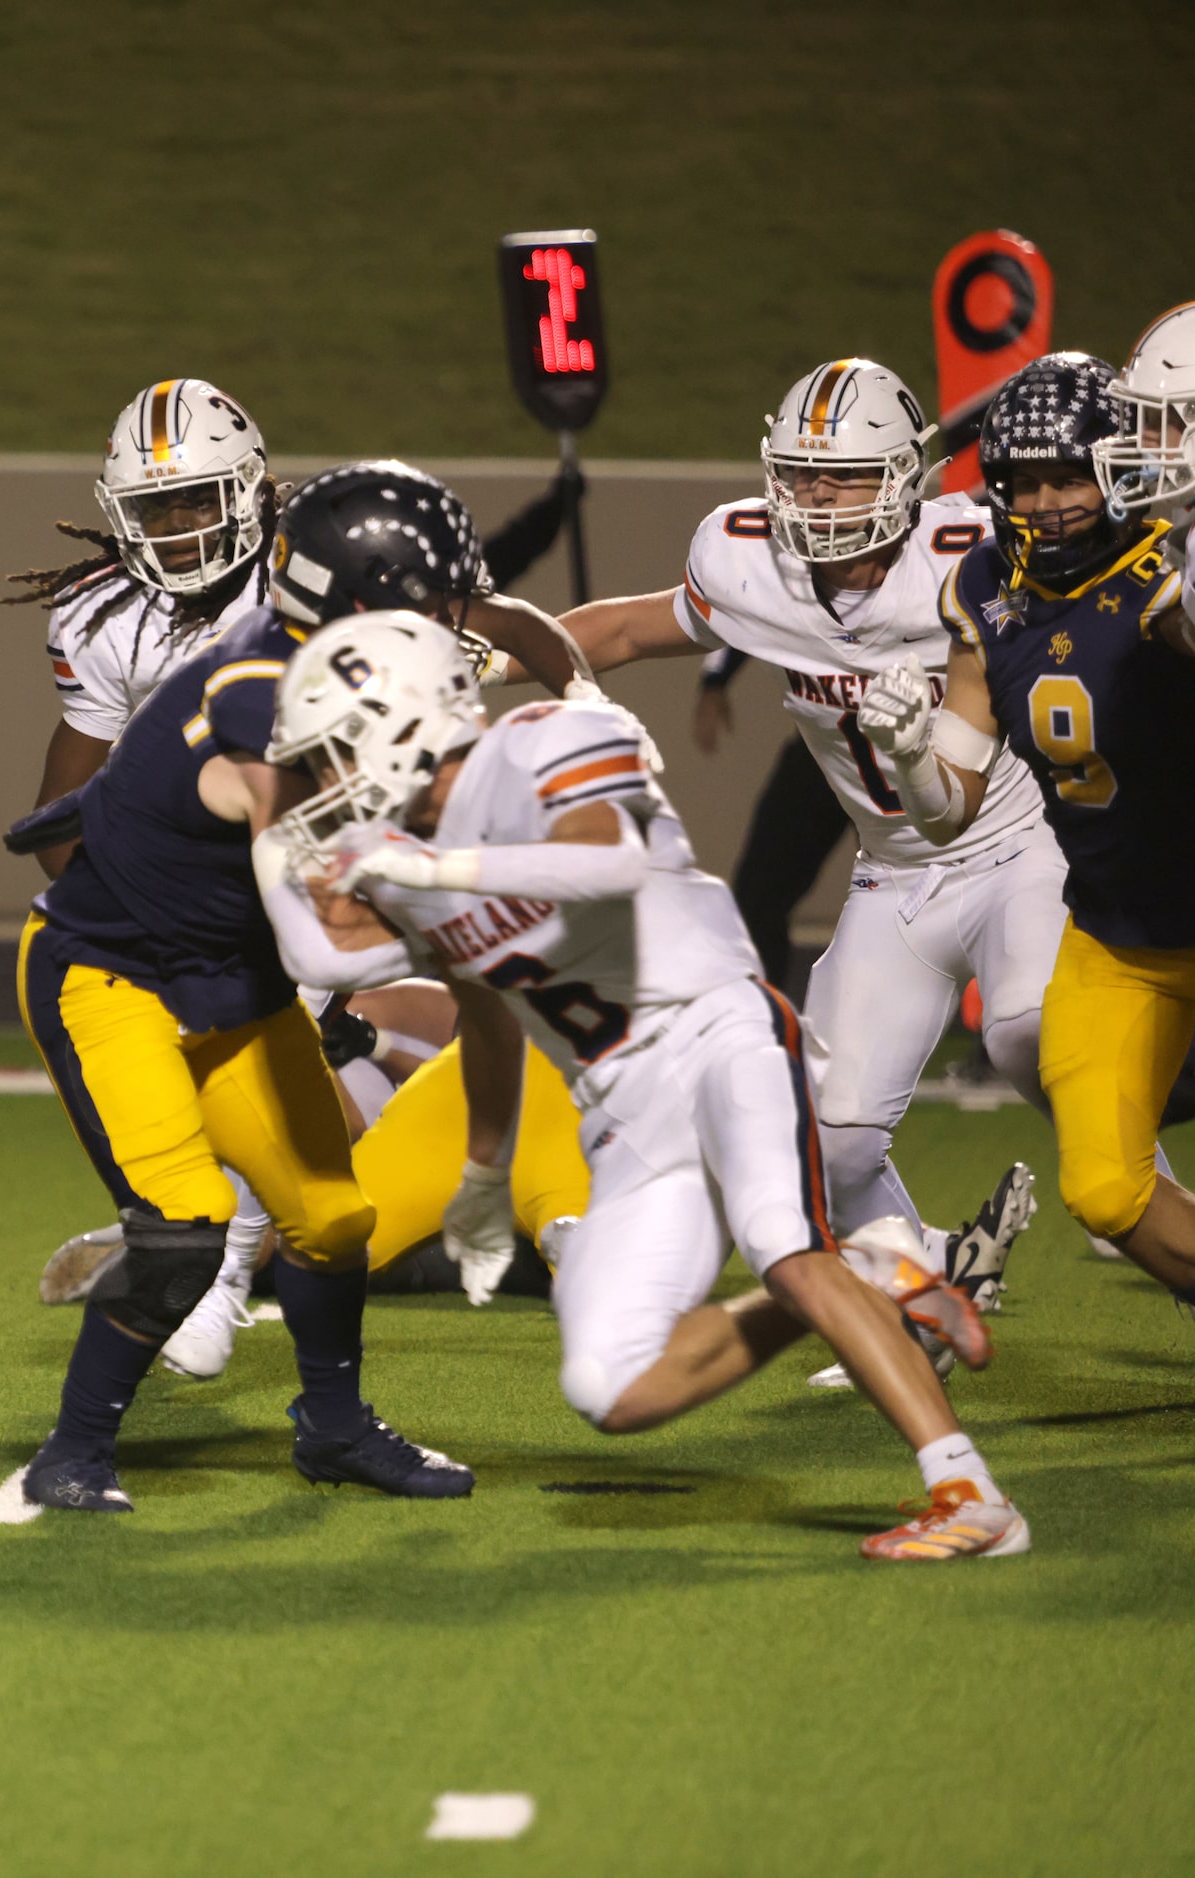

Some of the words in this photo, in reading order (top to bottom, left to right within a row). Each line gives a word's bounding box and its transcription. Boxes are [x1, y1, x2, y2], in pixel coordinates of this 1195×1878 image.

[1010, 446, 1057, 459] Riddell
[930, 523, 986, 555] 0
[328, 645, 374, 692] 6
[785, 667, 945, 712] WAKED
[1028, 674, 1119, 809] 9
[481, 951, 632, 1067] 6
